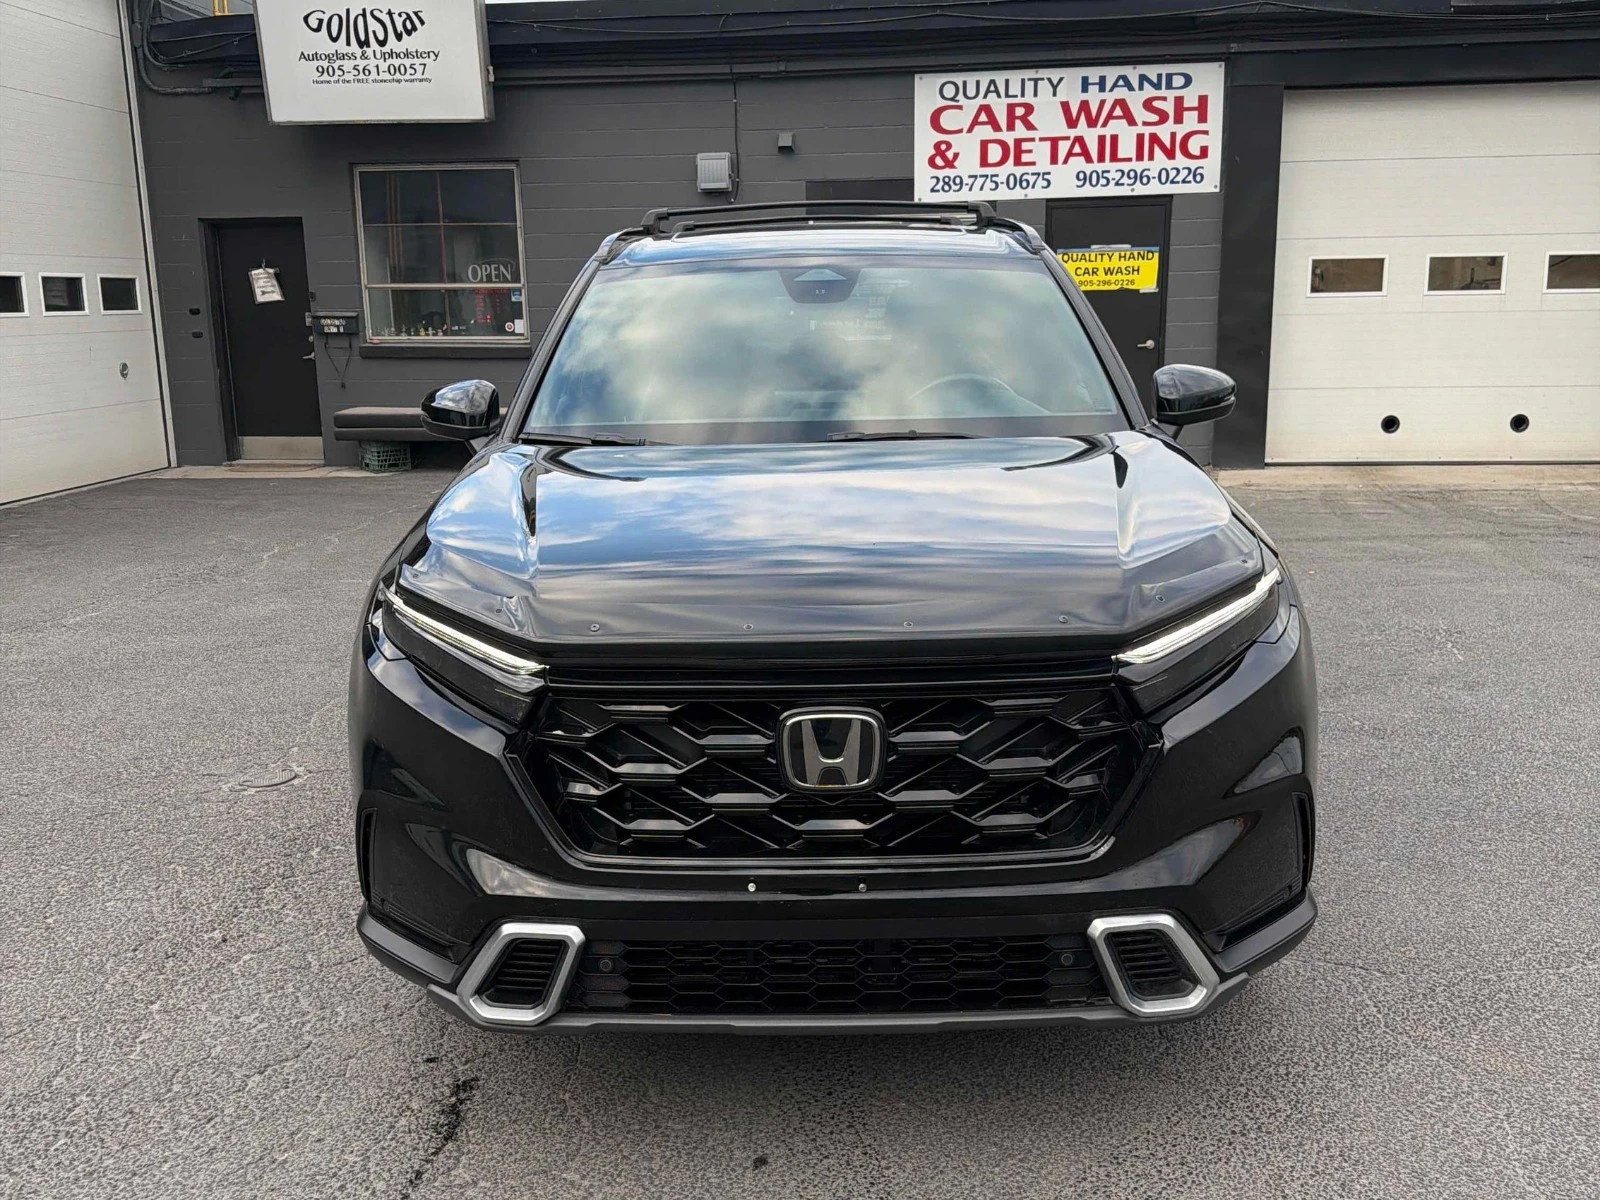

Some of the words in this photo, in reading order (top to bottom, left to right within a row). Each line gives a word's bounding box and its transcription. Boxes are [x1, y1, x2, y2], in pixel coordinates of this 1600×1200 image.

[303, 8, 426, 49] GoldStar
[298, 49, 357, 64] Autoglass
[359, 50, 371, 60] &
[373, 48, 440, 62] Upholstery
[316, 63, 427, 77] 905-561-0057
[403, 76, 432, 84] warranty
[938, 76, 1065, 103] QUALITY
[1080, 72, 1193, 94] HAND
[929, 101, 1039, 135] CAR
[1060, 94, 1209, 130] WASH
[927, 139, 960, 171] &
[979, 130, 1210, 168] DETAILING
[929, 171, 1052, 193] 289-775-0675
[1075, 166, 1205, 188] 905-296-0226
[1061, 252, 1115, 264] QUALITY
[1118, 250, 1154, 262] HAND
[468, 264, 511, 282] OPEN
[1074, 266, 1099, 277] CAR
[1103, 265, 1140, 276] WASH
[1078, 278, 1135, 287] 905-296-0226
